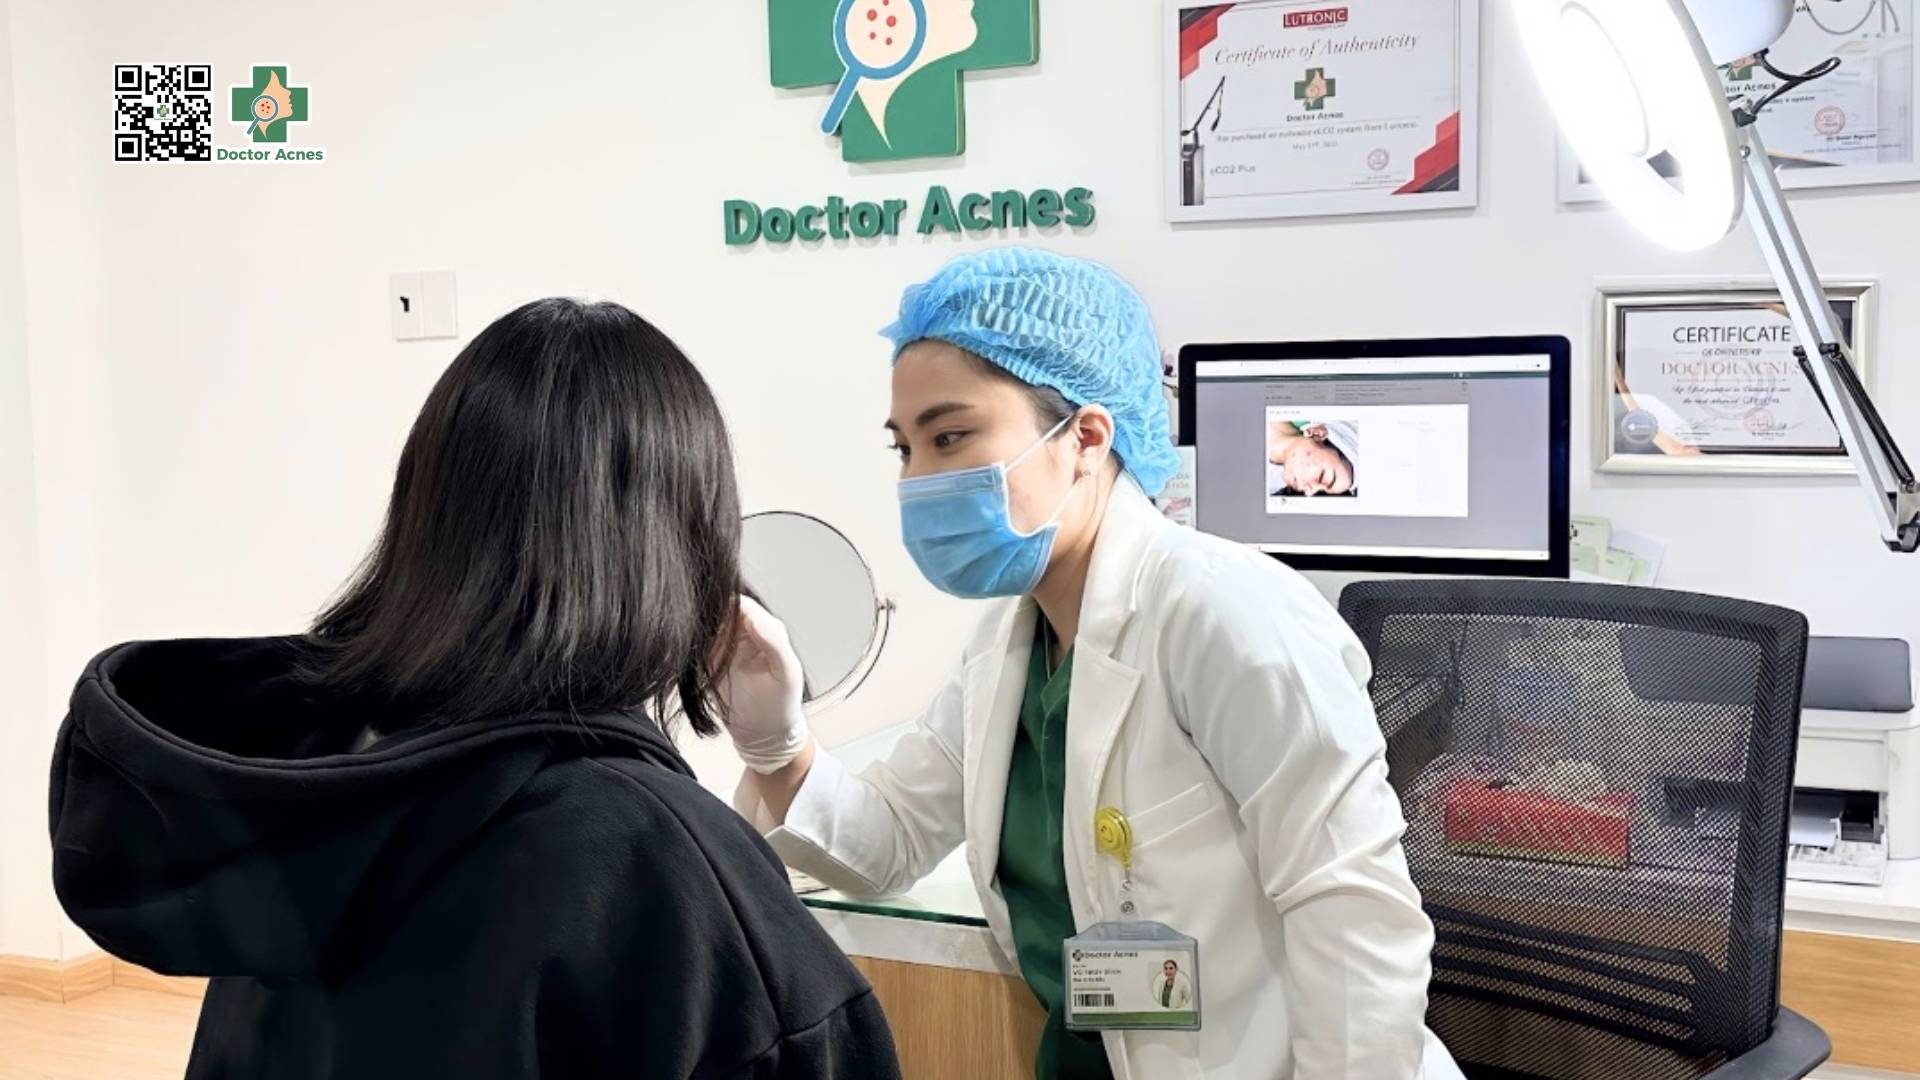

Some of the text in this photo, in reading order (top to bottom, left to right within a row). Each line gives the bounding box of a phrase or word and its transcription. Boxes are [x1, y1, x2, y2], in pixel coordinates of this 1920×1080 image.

[1284, 9, 1347, 27] LUTRONIC
[1214, 32, 1422, 67] Certificate of Authenticity
[723, 185, 1096, 247] Doctor Acnes
[1672, 325, 1792, 345] CERTIFICATE
[1661, 360, 1736, 377] DOCTOR
